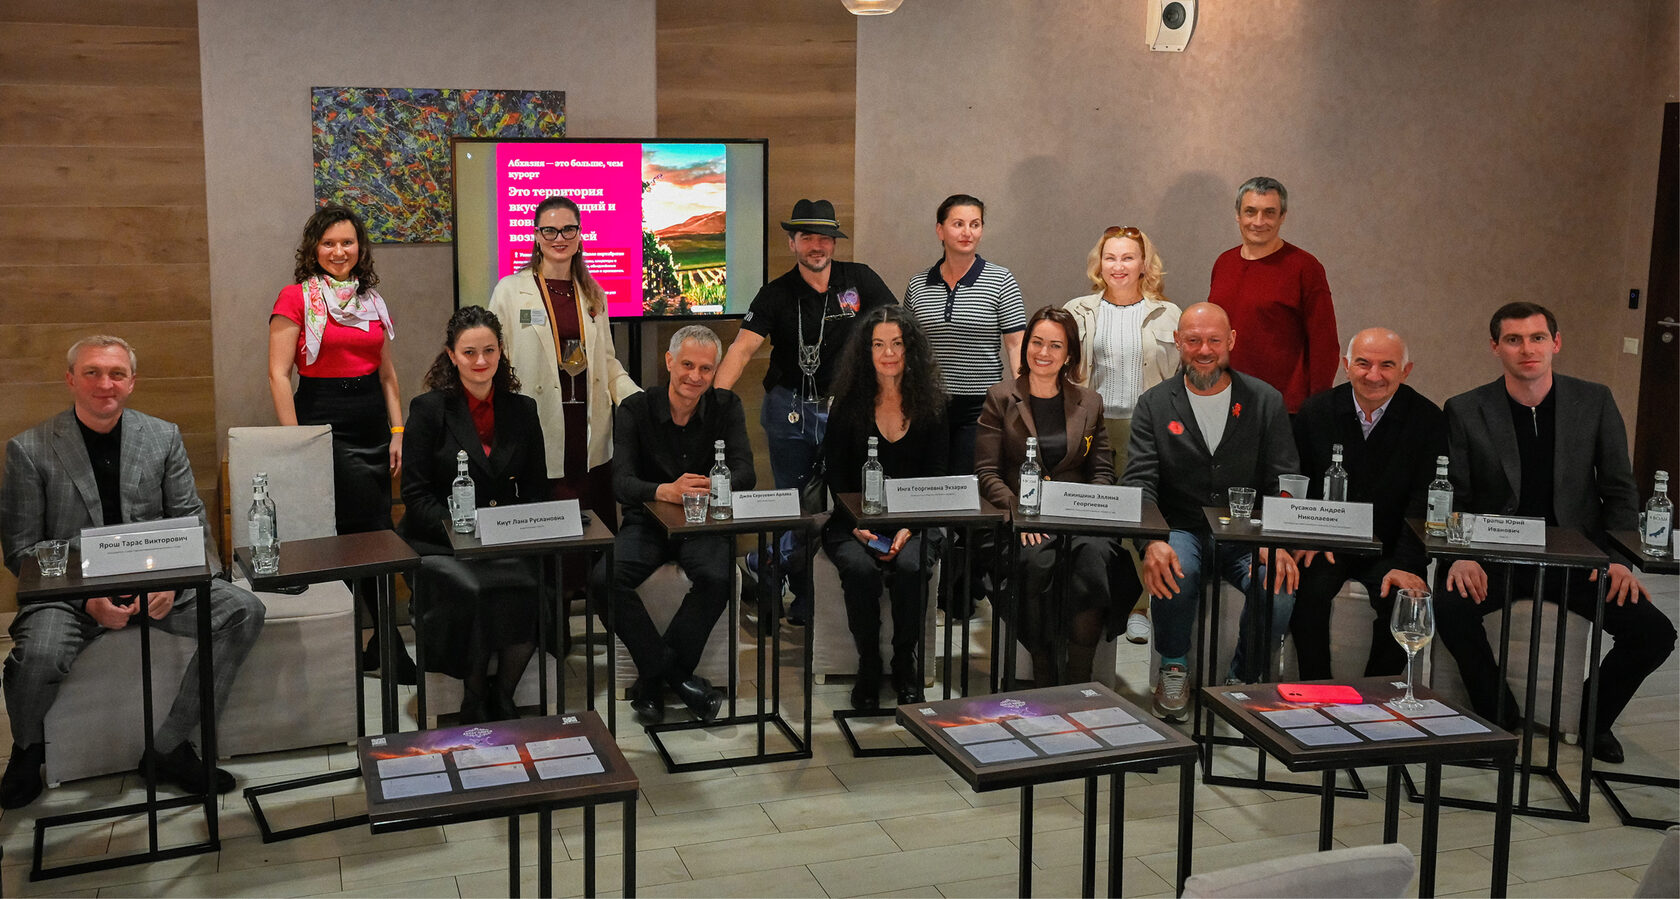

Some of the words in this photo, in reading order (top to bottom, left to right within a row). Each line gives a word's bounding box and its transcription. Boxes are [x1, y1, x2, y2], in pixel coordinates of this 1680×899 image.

[508, 158, 545, 167] Абхазия
[571, 159, 606, 168] больше,
[508, 171, 540, 180] курорт
[508, 186, 531, 197] Это
[532, 187, 603, 199] территория
[608, 203, 616, 211] и
[1073, 500, 1109, 508] Георгиевна
[1290, 503, 1317, 511] Русаков
[1319, 506, 1346, 514] Андрей
[529, 515, 565, 524] Руслановна
[1297, 513, 1338, 522] Николаевич
[1487, 526, 1520, 534] Иванович
[99, 541, 120, 550] Ярош
[122, 539, 143, 547] Тарас
[144, 535, 188, 545] Викторович
